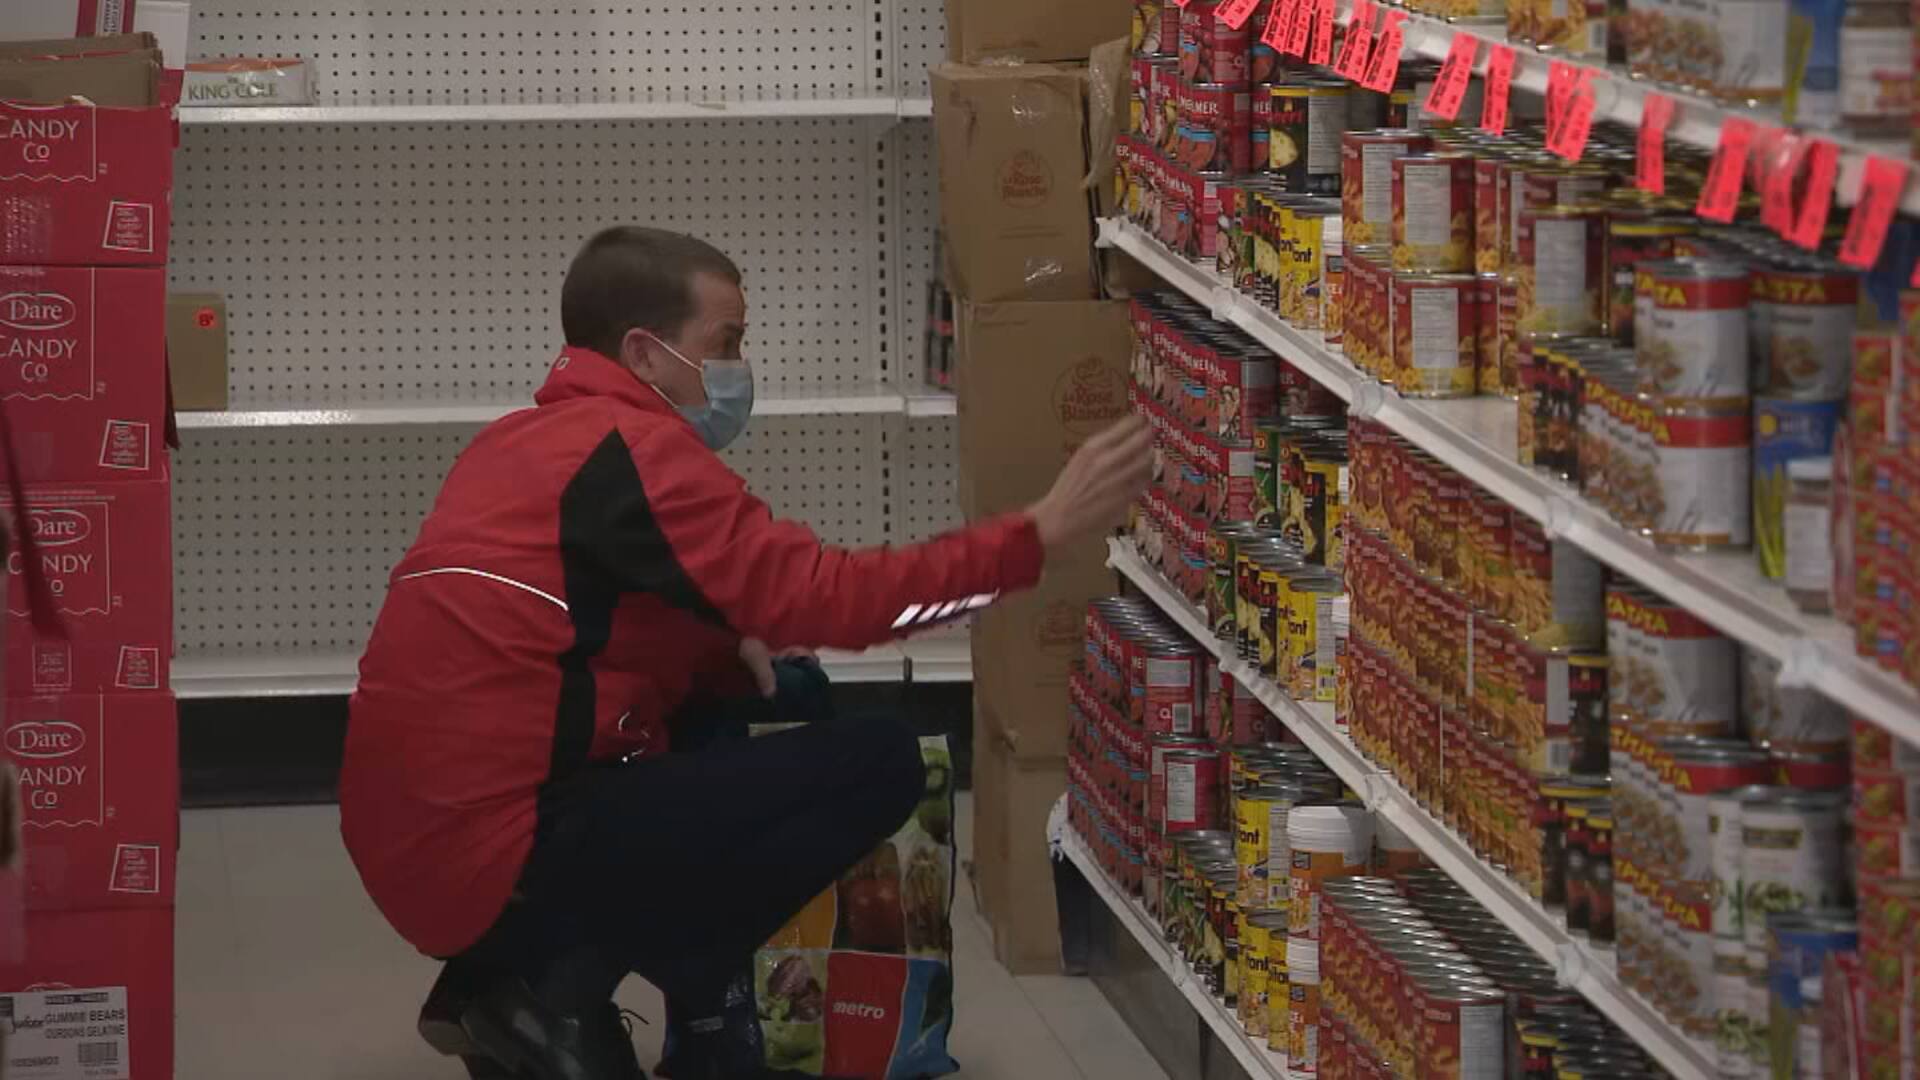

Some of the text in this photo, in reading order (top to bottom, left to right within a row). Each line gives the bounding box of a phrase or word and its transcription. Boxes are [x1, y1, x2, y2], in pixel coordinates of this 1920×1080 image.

[189, 82, 278, 100] KING COLE
[23, 141, 50, 163] Co
[9, 299, 63, 321] Dare
[21, 361, 48, 383] Co
[7, 551, 93, 575] CNDY
[18, 729, 72, 749] Dare
[18, 765, 87, 786] ANDY
[32, 788, 58, 809] Co
[89, 1008, 126, 1022] BEARS
[832, 1000, 885, 1020] metro
